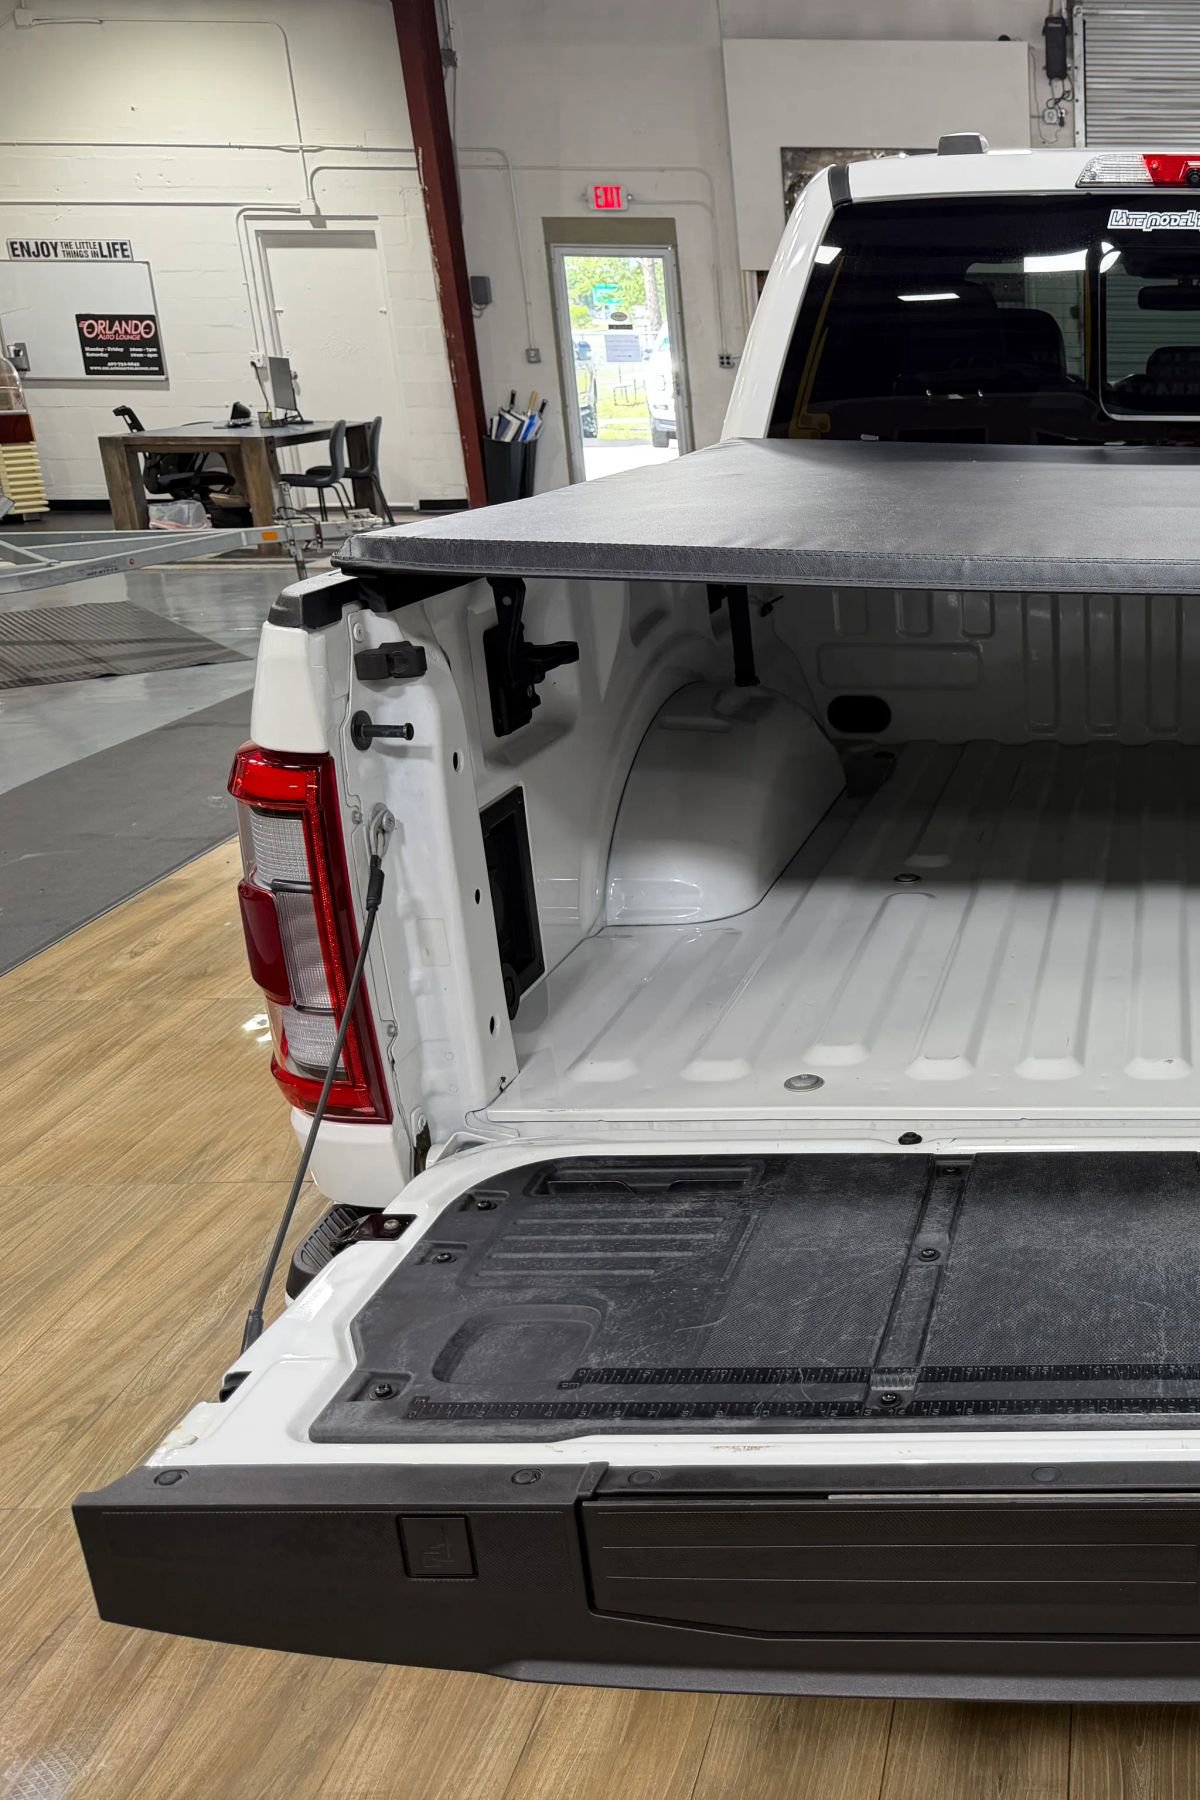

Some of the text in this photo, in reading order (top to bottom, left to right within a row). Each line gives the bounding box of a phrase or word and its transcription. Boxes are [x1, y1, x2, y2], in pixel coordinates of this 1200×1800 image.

[593, 185, 622, 209] EXIT
[1109, 210, 1145, 228] LATE
[10, 241, 58, 258] ENJOY
[61, 241, 97, 250] THE LITTLE
[62, 250, 99, 258] THINGS IN
[98, 241, 130, 258] LIFE
[83, 320, 155, 338] ORLANDO
